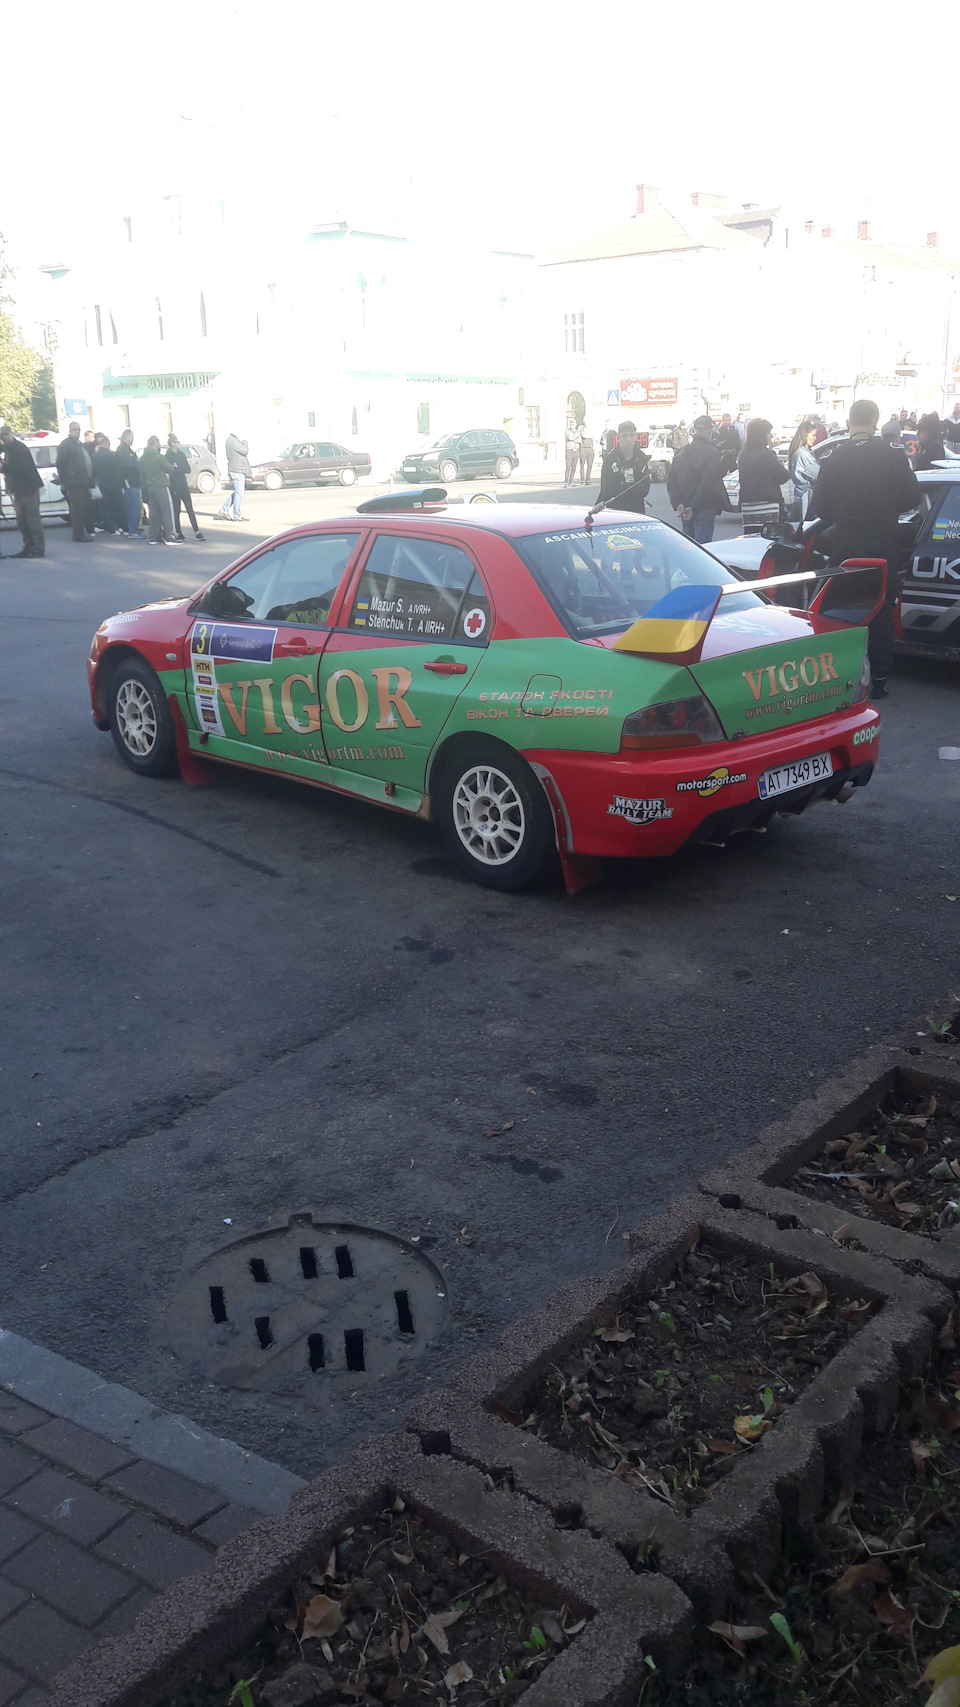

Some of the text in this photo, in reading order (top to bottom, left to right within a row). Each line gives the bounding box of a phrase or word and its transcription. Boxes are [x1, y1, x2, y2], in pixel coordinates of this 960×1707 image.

[947, 519, 960, 529] Ne
[544, 524, 664, 544] ASCANIA-RACING.COM
[370, 596, 395, 612] Mazur
[396, 598, 404, 613] S.
[368, 614, 404, 630] Stenchuk
[196, 625, 208, 653] 3
[742, 651, 840, 701] VIGOR
[217, 666, 421, 736] VIGOR
[479, 689, 613, 702] ЕТАЛОН ЯКОСТІ
[746, 684, 842, 720] www.vigortm.com
[466, 708, 508, 720] ВІКОН
[264, 743, 405, 766] www.vigortm.com
[676, 772, 747, 791] motorsport.com
[768, 770, 781, 792] AT
[783, 762, 810, 788] 7349
[812, 755, 829, 777] BX
[609, 806, 672, 818] RALLY TEAM
[614, 797, 662, 811] MAZUR
